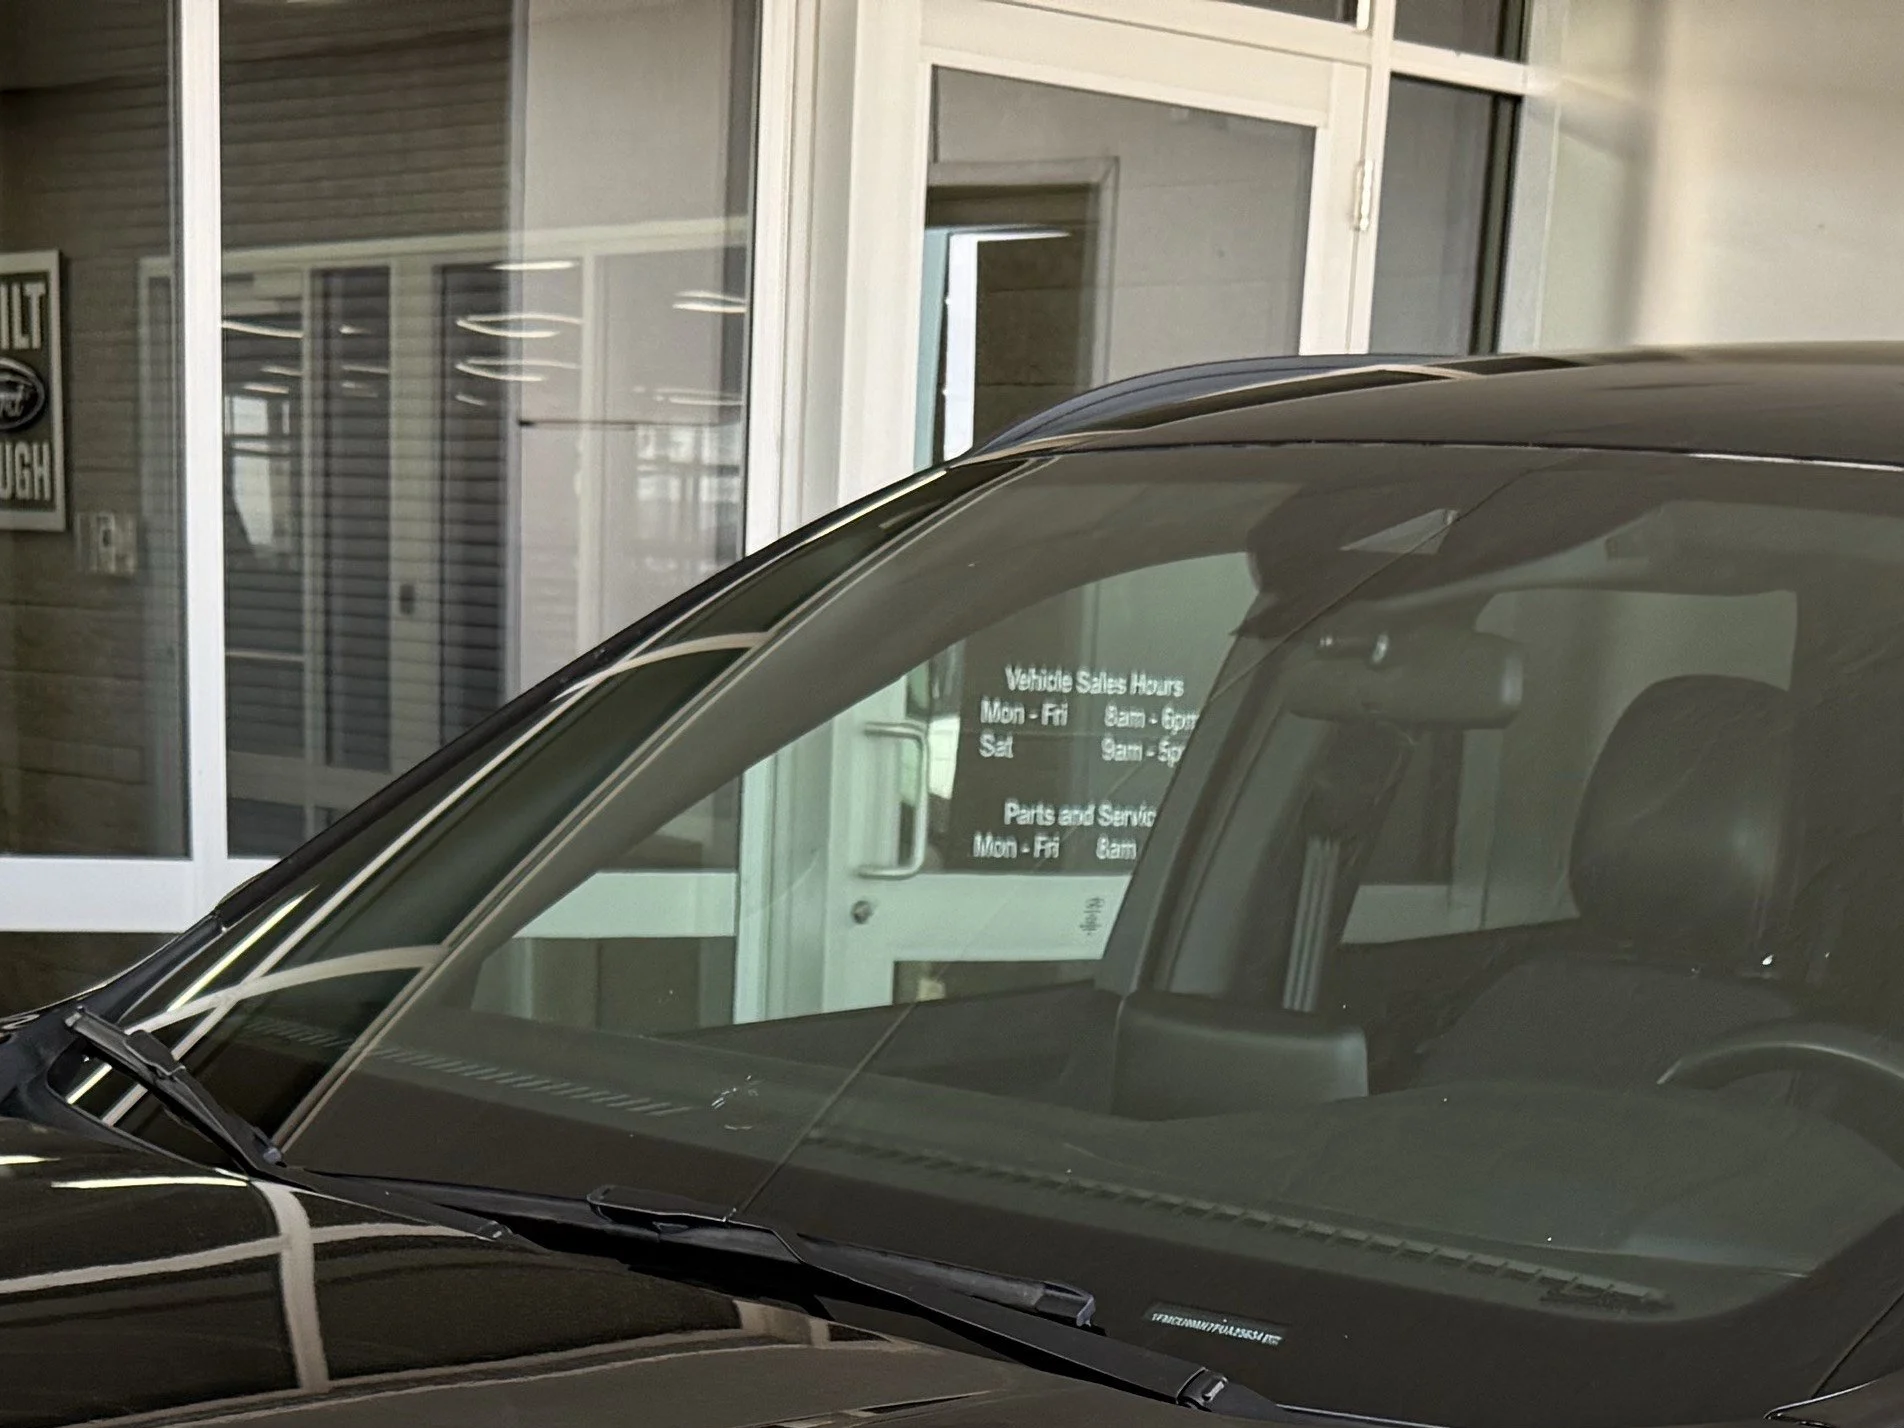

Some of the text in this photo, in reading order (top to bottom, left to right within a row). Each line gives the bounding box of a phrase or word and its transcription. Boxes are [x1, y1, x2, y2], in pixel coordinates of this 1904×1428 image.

[1005, 665, 1184, 698] Vehicle Sales Hours
[981, 697, 1026, 724] Mon
[1041, 701, 1068, 726] Fri
[1104, 703, 1145, 728] 8am
[979, 732, 1013, 758] Sat
[1101, 735, 1143, 761] 9am
[1157, 738, 1185, 768] 5p
[1004, 799, 1157, 827] Parts and Servic
[973, 831, 1017, 858] Mon
[1033, 832, 1060, 858] Fri
[1096, 834, 1137, 860] 8am
